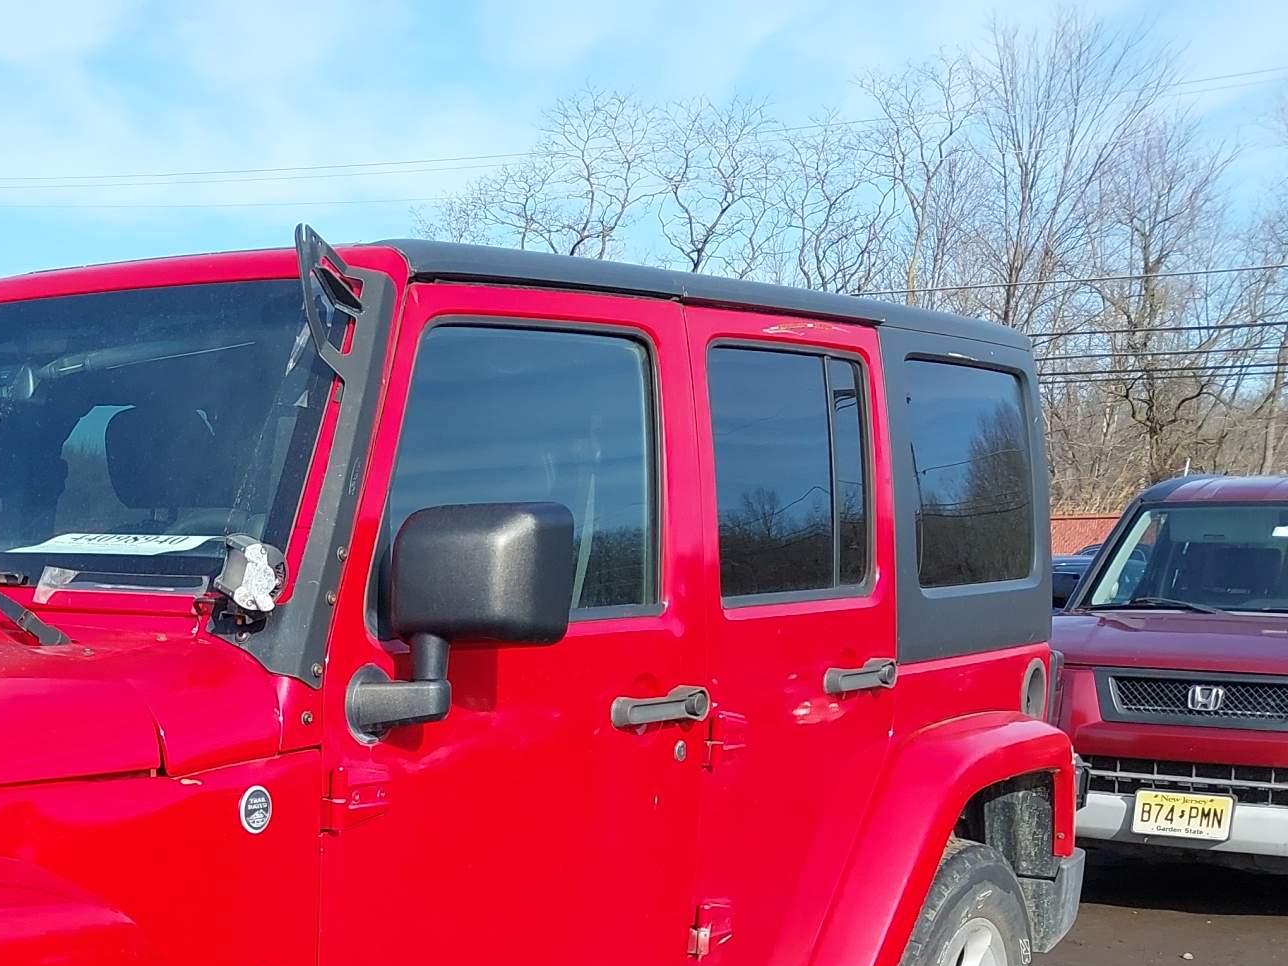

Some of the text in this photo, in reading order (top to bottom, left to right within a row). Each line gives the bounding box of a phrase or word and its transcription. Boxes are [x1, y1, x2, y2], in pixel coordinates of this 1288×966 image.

[1160, 794, 1208, 805] New Jersey
[1140, 803, 1224, 829] B74 PMN
[1156, 825, 1204, 835] Garden State
